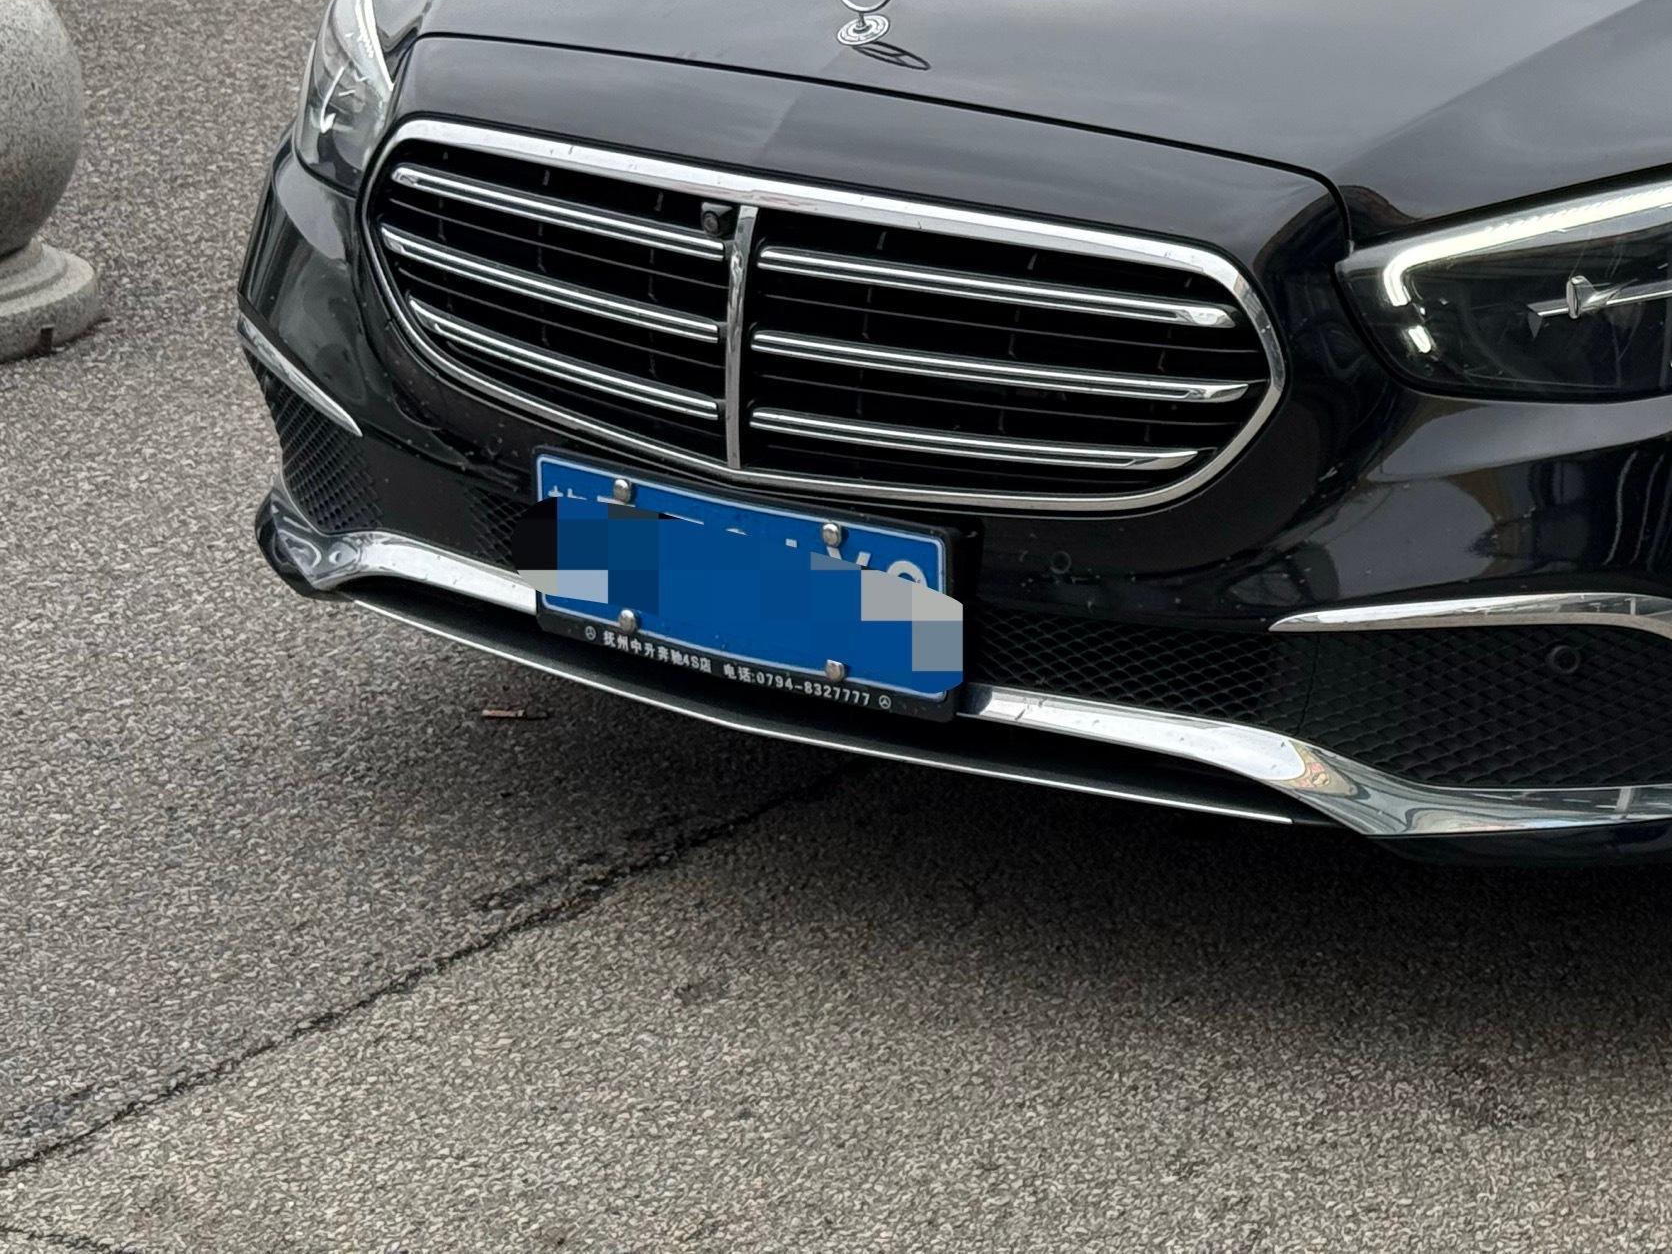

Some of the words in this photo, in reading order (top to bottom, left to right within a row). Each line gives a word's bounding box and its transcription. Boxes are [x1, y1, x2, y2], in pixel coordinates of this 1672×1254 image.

[603, 630, 712, 674] 抚州中升奔驰4S店
